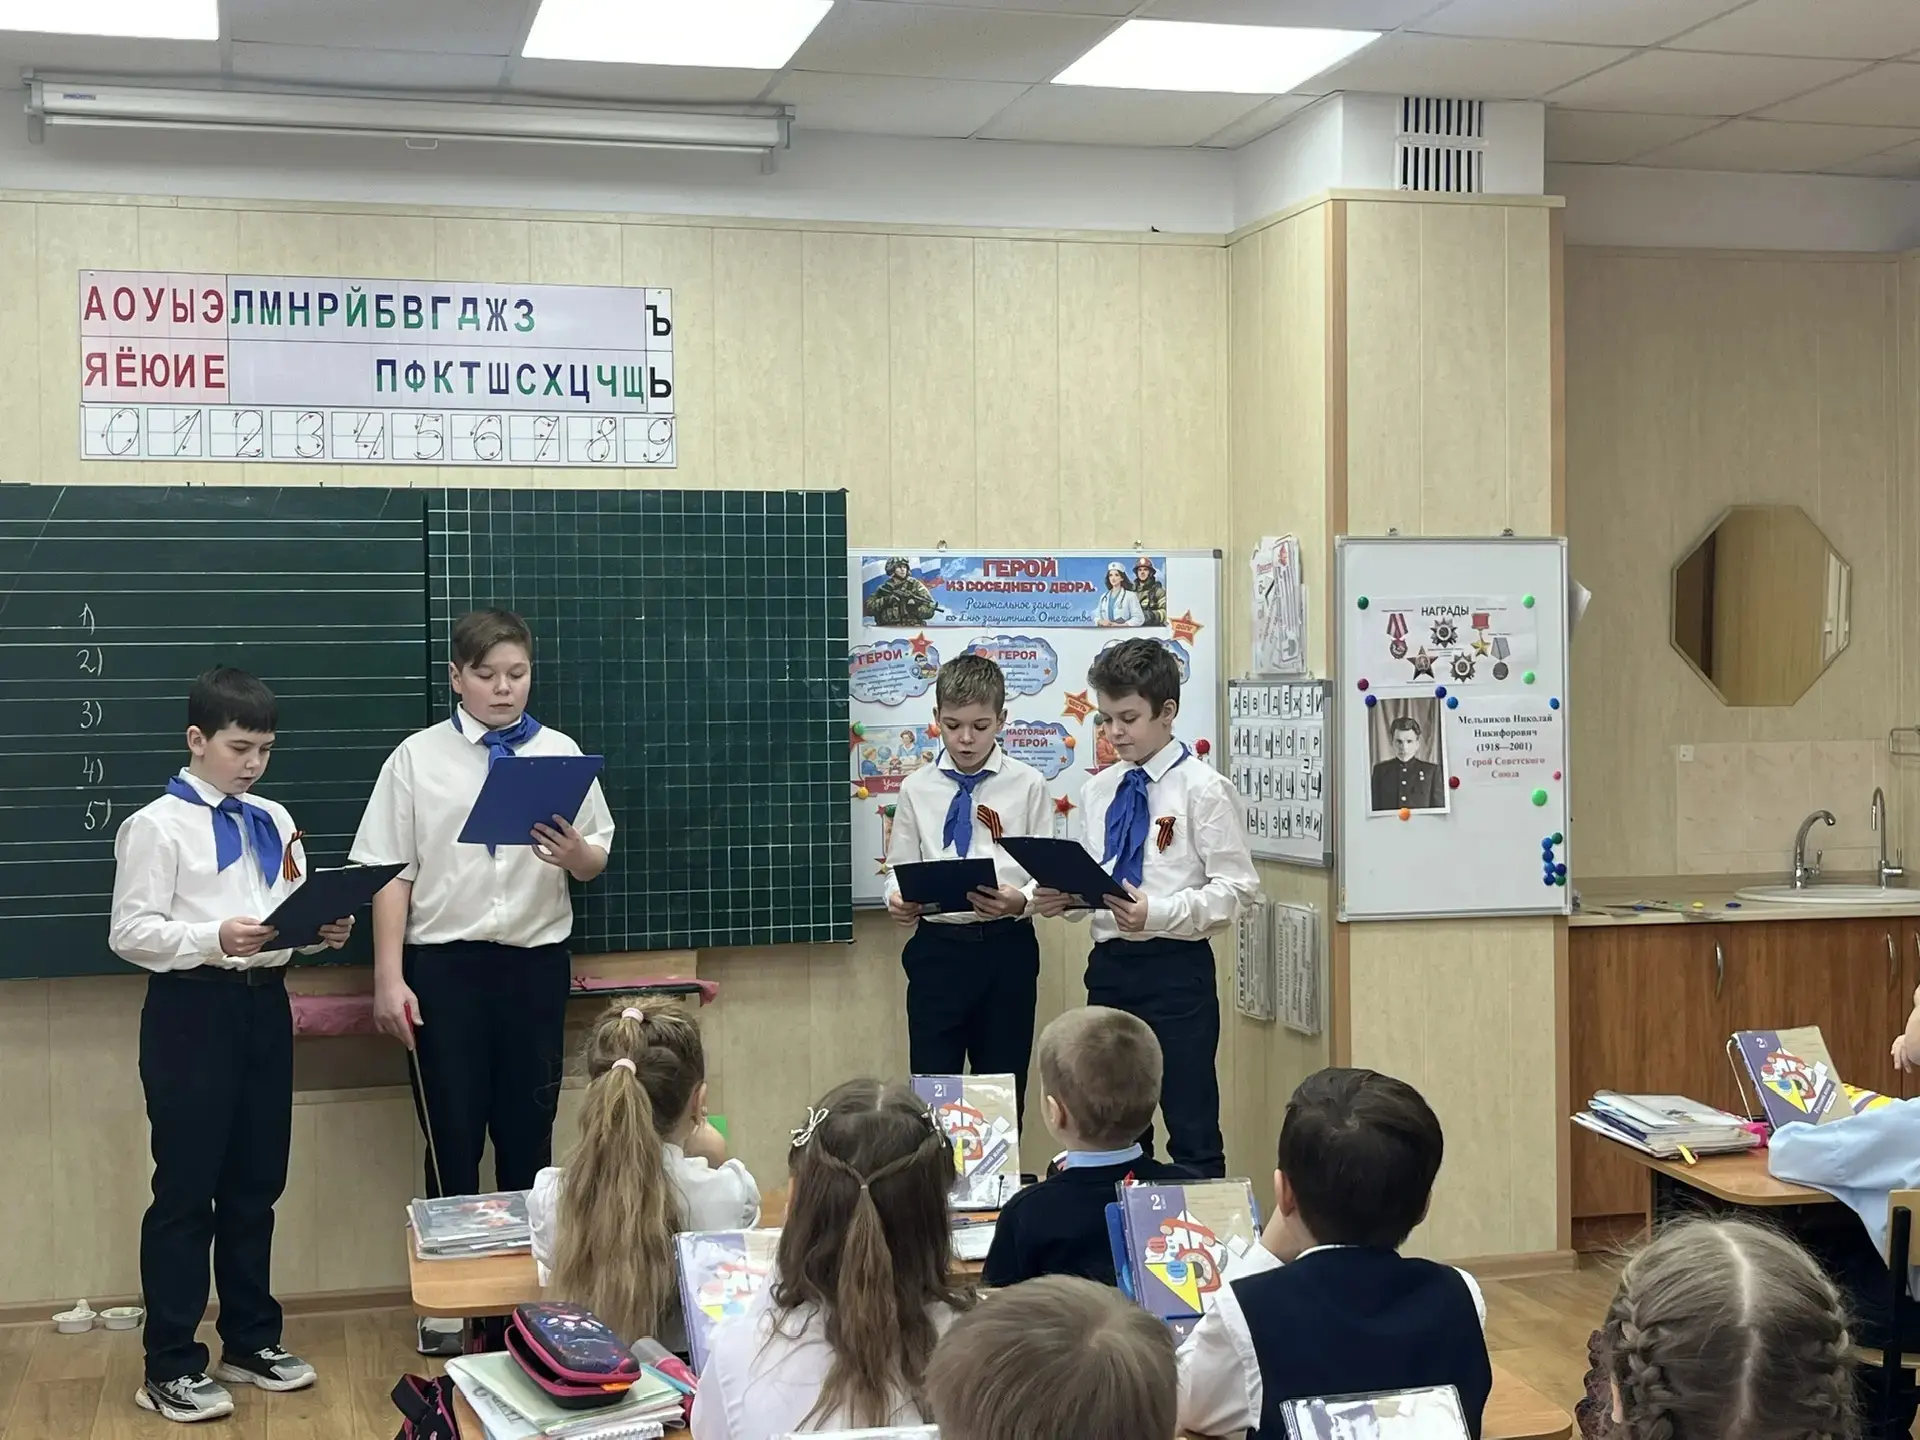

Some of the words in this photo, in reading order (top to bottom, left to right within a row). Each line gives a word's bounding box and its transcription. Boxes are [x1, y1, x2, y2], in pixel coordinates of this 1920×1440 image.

[645, 304, 672, 336] Ъ
[650, 366, 672, 398] Ь
[106, 408, 139, 455] 0
[174, 409, 201, 455] 1
[236, 410, 263, 456] 2
[295, 411, 324, 457] 3
[355, 413, 385, 458] 4
[414, 414, 443, 459] 5
[474, 415, 502, 460] 6
[534, 416, 560, 461] 7
[587, 417, 616, 462] 8
[645, 418, 673, 463] 9
[983, 557, 1058, 577] ГЕРОЙ
[946, 581, 964, 592] ИЗ
[966, 581, 1046, 593] СОСЕДНЕГО
[1049, 581, 1097, 593] ДВОРА.
[965, 597, 1030, 610] Региональное
[1421, 605, 1470, 617] НАГРАДЫ
[78, 602, 95, 636] 1)
[983, 614, 1036, 627] защитника
[1038, 611, 1093, 623] Отечества
[76, 647, 103, 677] 2)
[998, 651, 1037, 660] ГЕРОЯ
[80, 700, 103, 729] 3)
[1458, 715, 1511, 724] Мельников
[1513, 714, 1553, 723] Николай
[1474, 728, 1538, 739] Никифорович
[1012, 738, 1048, 748] ГЕРОЙ
[1466, 757, 1492, 768] Герой
[1494, 756, 1545, 765] Советского
[82, 756, 104, 784] 4)
[1491, 769, 1519, 778] Союза
[84, 798, 112, 830] 5)
[1756, 1037, 1766, 1048] 2
[934, 1084, 943, 1097] 2
[1151, 1194, 1161, 1210] 2
